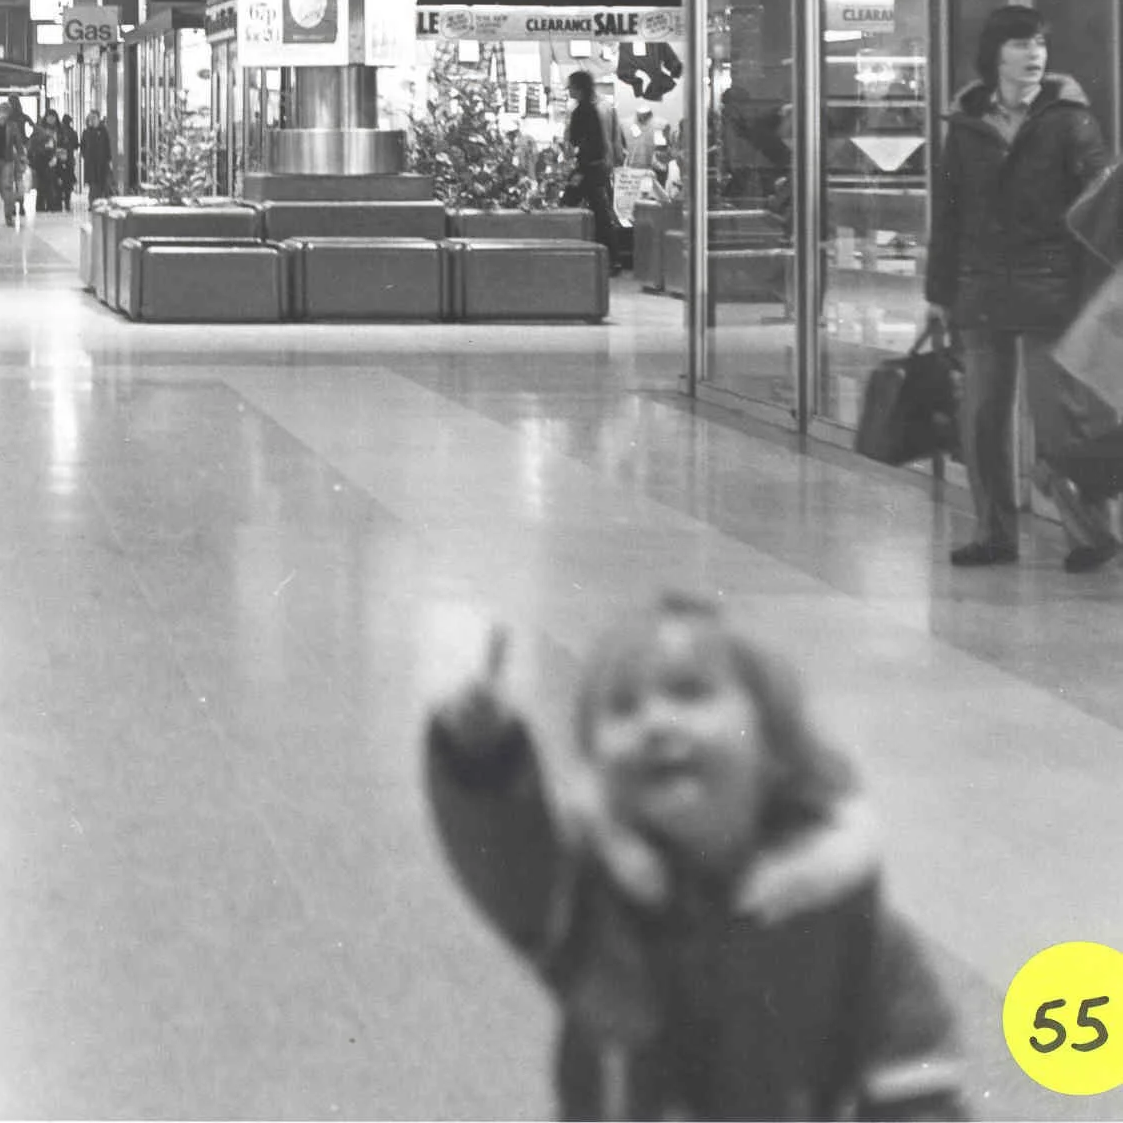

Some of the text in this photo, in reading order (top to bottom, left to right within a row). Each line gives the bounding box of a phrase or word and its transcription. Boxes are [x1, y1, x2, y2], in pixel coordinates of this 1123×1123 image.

[65, 18, 112, 41] Gas
[525, 18, 592, 33] CLEARANCE
[593, 12, 638, 36] SALE
